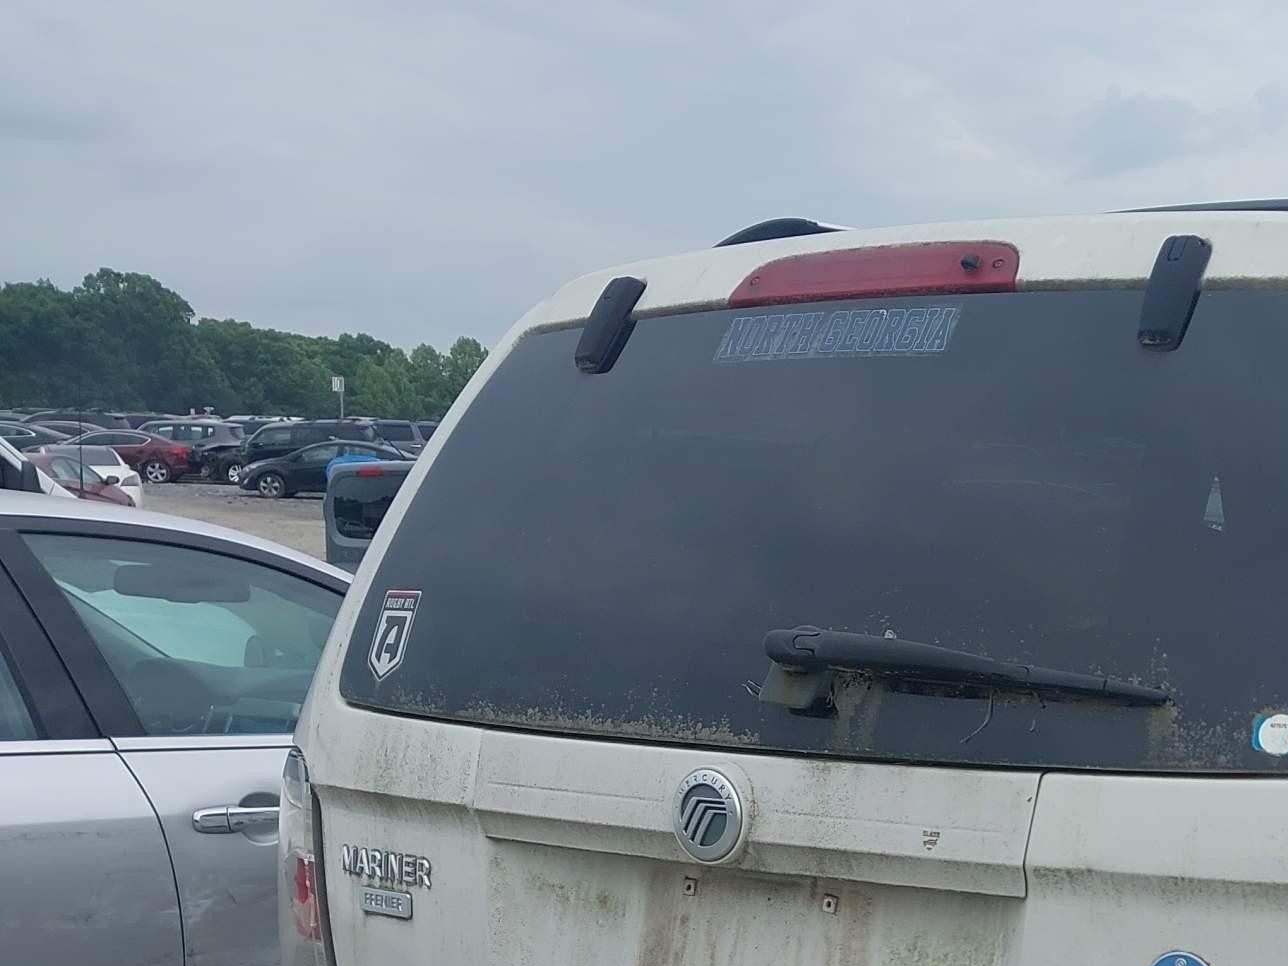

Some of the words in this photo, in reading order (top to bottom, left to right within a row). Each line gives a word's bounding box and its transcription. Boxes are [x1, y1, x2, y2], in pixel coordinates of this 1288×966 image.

[718, 311, 824, 356] NORTH
[818, 307, 956, 353] GEORGIA
[679, 773, 733, 801] MERCURY
[341, 844, 432, 889] MARINER
